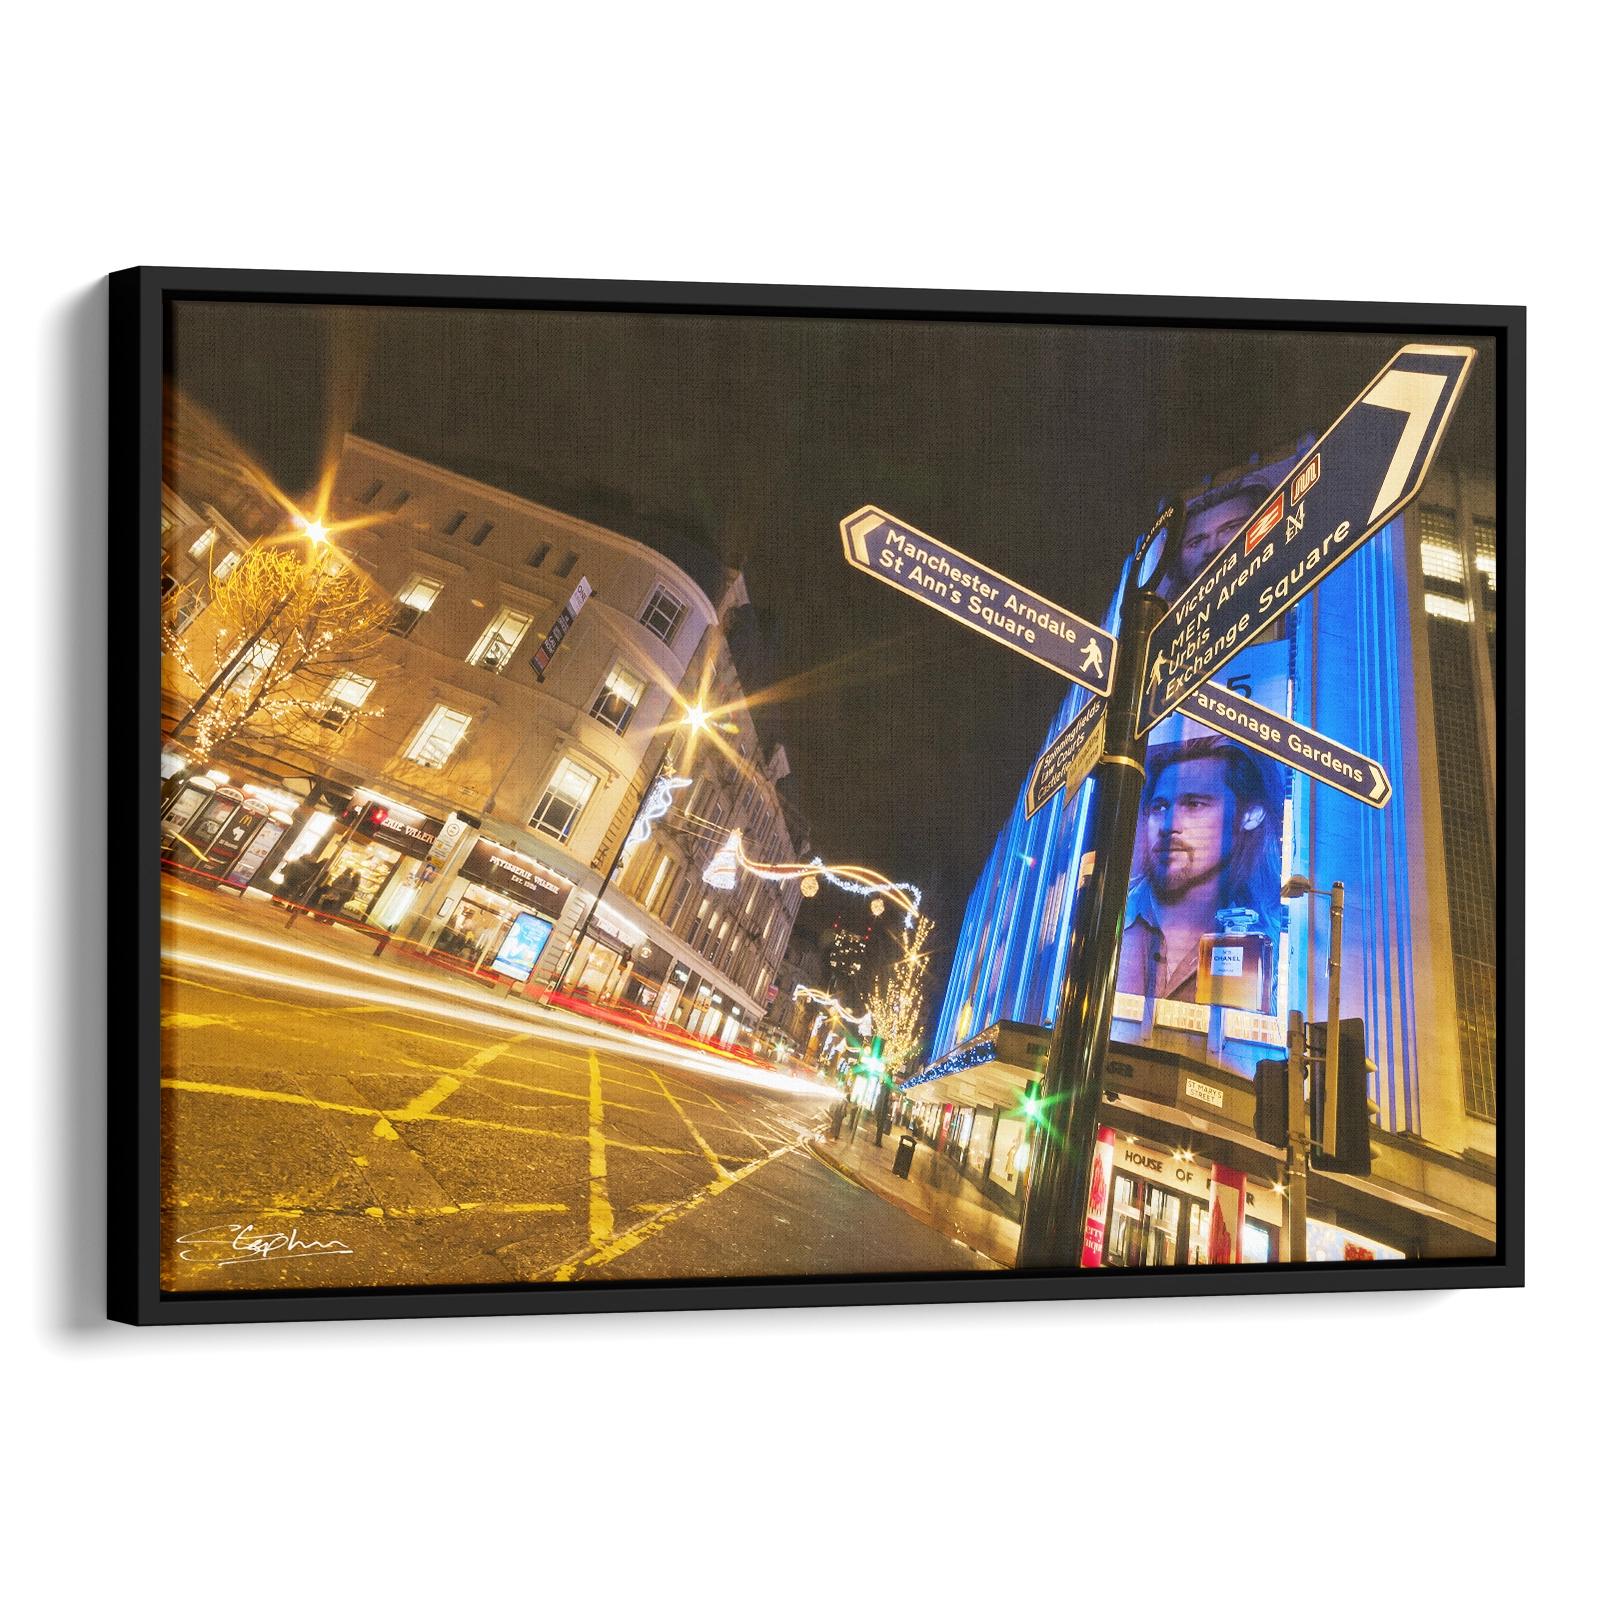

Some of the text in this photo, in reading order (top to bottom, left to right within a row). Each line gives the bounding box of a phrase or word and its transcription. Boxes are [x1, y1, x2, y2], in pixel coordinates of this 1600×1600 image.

[879, 549, 1036, 644] St Ann's Square
[885, 529, 1077, 643] Manchester Arndale
[1171, 609, 1210, 656] MEN
[1216, 543, 1274, 610] Arena
[1175, 553, 1237, 625] Victoria
[1165, 521, 1350, 701] Exchange Square
[1169, 627, 1210, 675] Urbis
[1227, 674, 1251, 699] 5
[1044, 701, 1100, 768] Spinningfields
[1057, 732, 1085, 767] Courts
[1288, 734, 1363, 782] Gardens
[489, 855, 560, 895] PATISSERIE VALERIE
[1190, 1089, 1215, 1103] STREET
[1125, 1150, 1194, 1184] HOUSE OF
